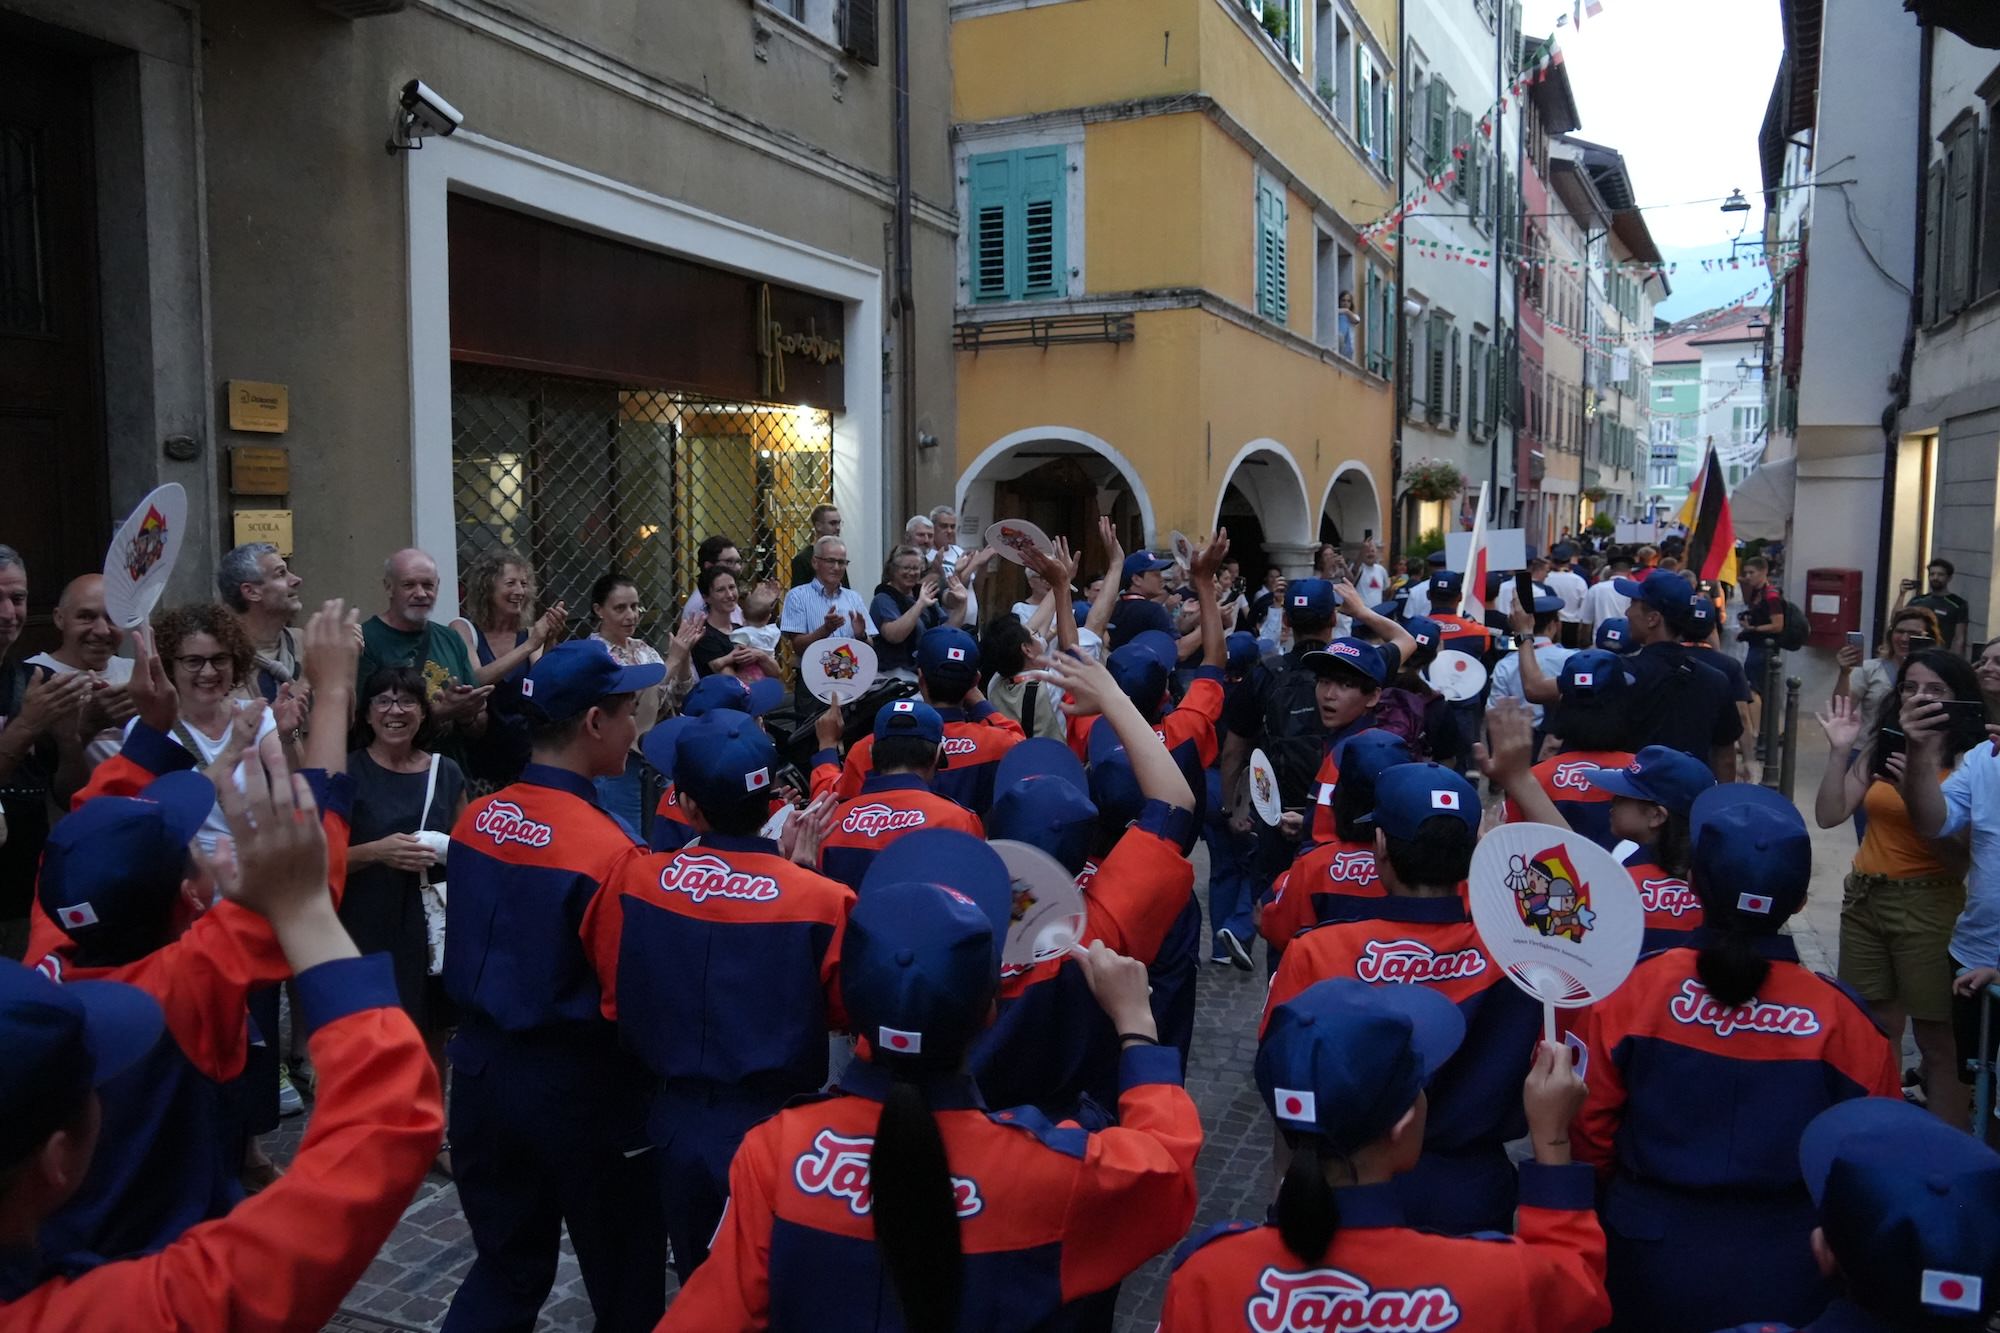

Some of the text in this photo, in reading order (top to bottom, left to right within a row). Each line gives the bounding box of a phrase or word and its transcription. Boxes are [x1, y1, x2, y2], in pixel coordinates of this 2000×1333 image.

[247, 522, 280, 532] SCUOLA
[475, 799, 552, 848] Japan
[841, 803, 926, 837] Japan
[659, 853, 780, 903] Japan
[1329, 850, 1379, 886] Jap
[1640, 877, 1702, 916] Jap
[1356, 939, 1487, 984] Japan
[1670, 977, 1820, 1036] Japan
[1247, 1266, 1462, 1333] Japan
